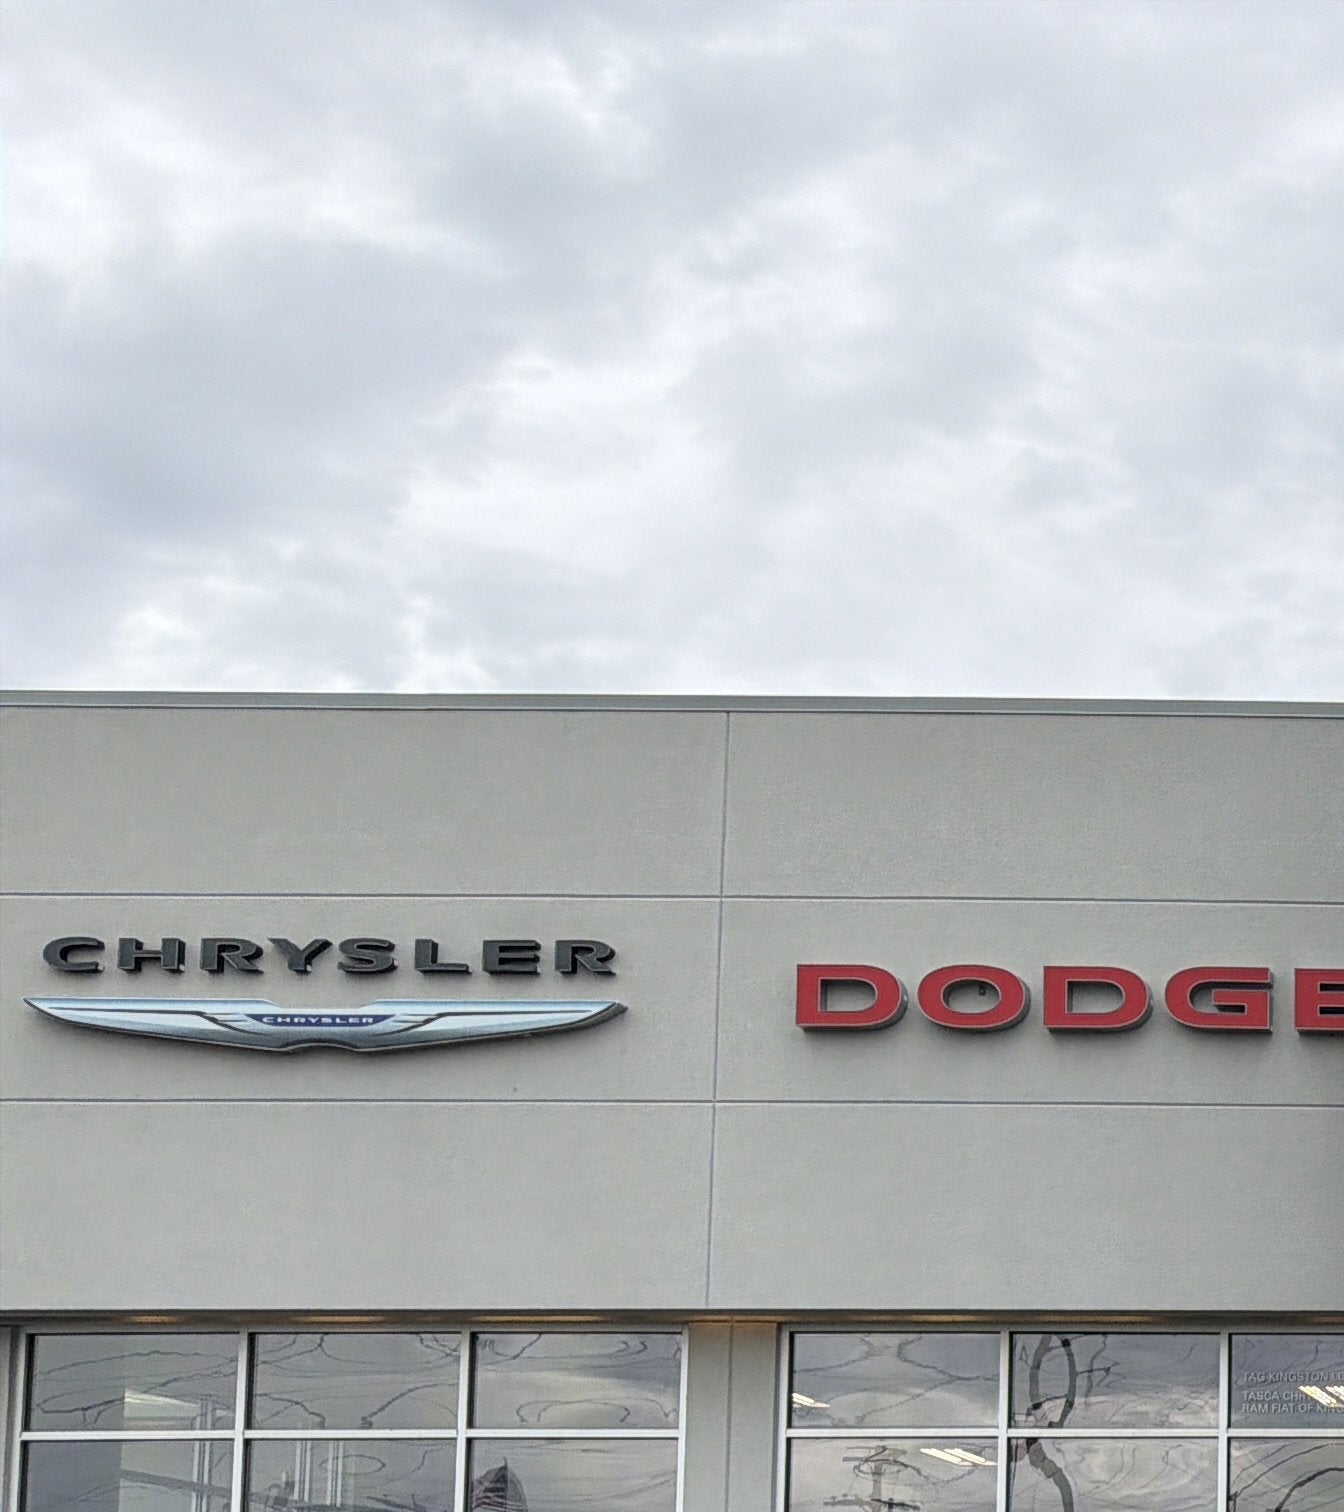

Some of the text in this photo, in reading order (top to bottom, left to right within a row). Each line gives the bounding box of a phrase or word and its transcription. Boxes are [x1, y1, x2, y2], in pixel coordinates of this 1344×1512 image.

[43, 936, 617, 975] CHRYSLER
[262, 1016, 374, 1024] CHRYSLER
[1268, 1371, 1328, 1383] KINGSTON
[1242, 1391, 1280, 1401] TASCA
[1271, 1403, 1296, 1414] FIAT
[1298, 1403, 1313, 1414] OF
